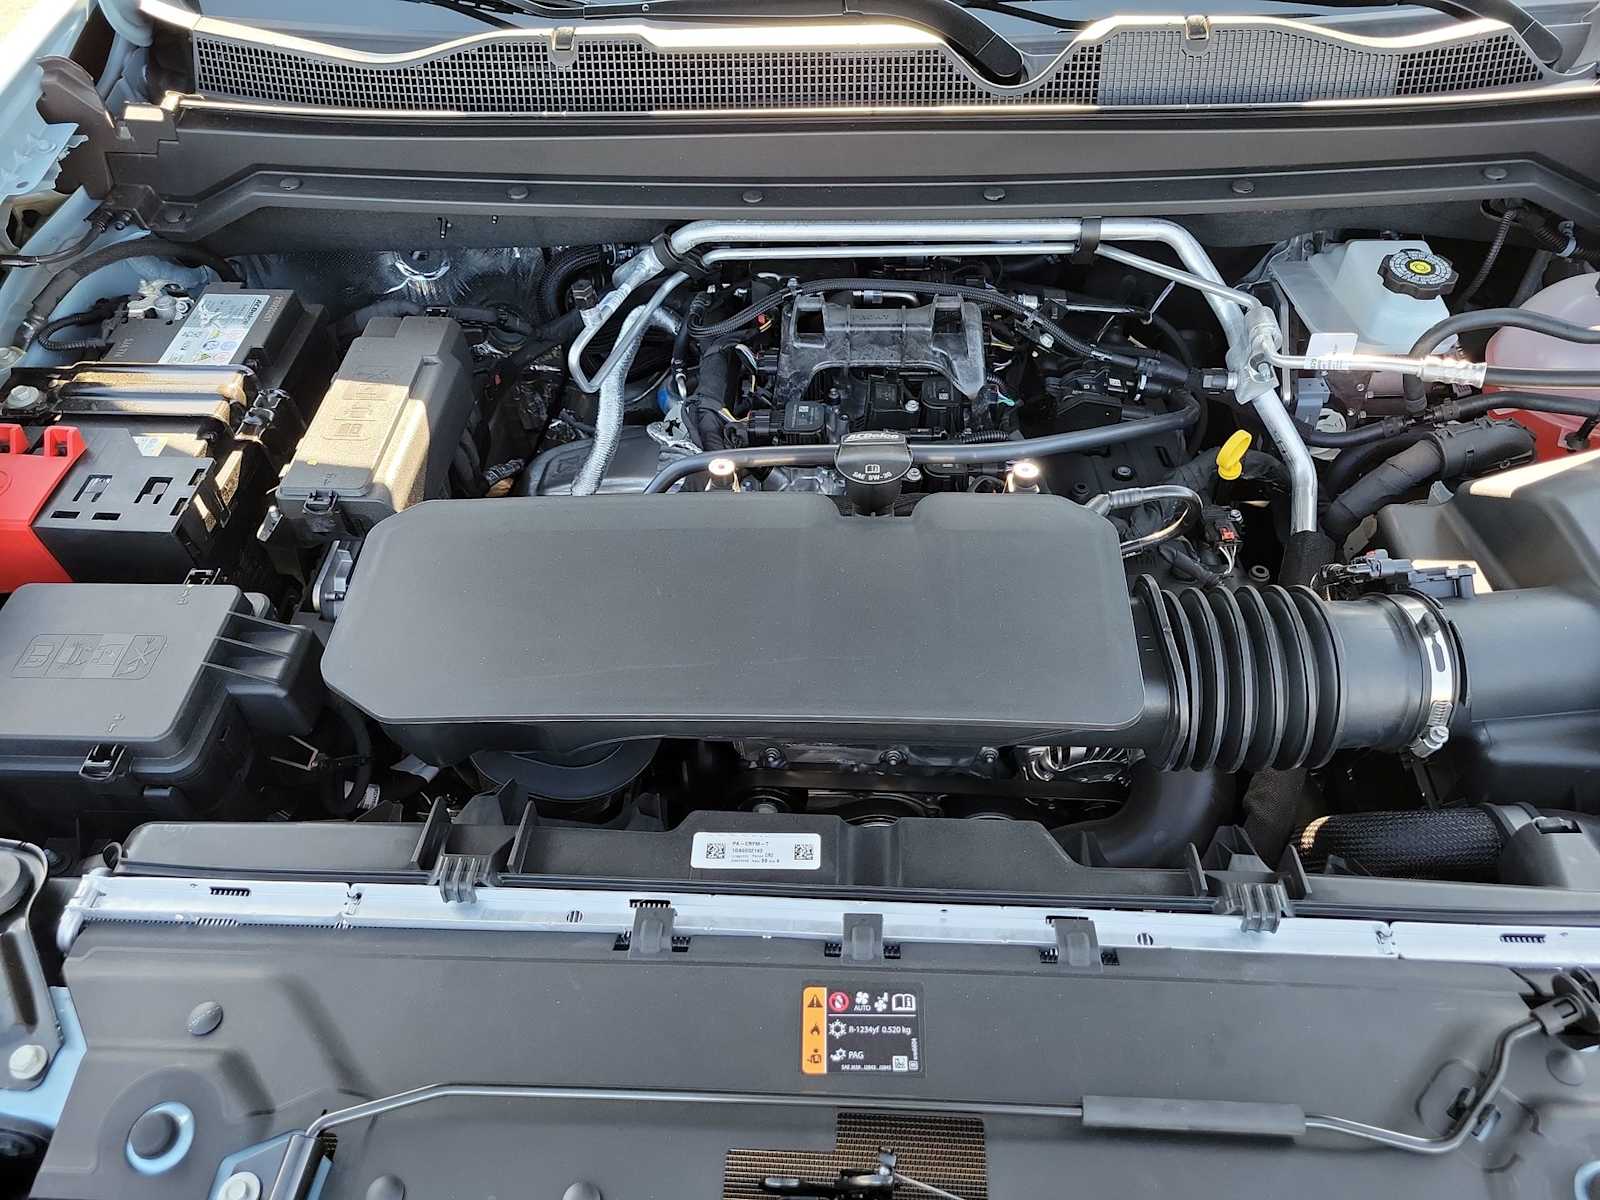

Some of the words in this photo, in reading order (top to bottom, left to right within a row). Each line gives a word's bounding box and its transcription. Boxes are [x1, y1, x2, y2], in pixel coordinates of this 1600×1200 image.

[844, 432, 899, 442] ACDelco
[848, 1025, 880, 1035] R-1234yf
[881, 1026, 901, 1034] 0.520
[901, 1026, 912, 1036] kg
[848, 1051, 864, 1059] PAG
